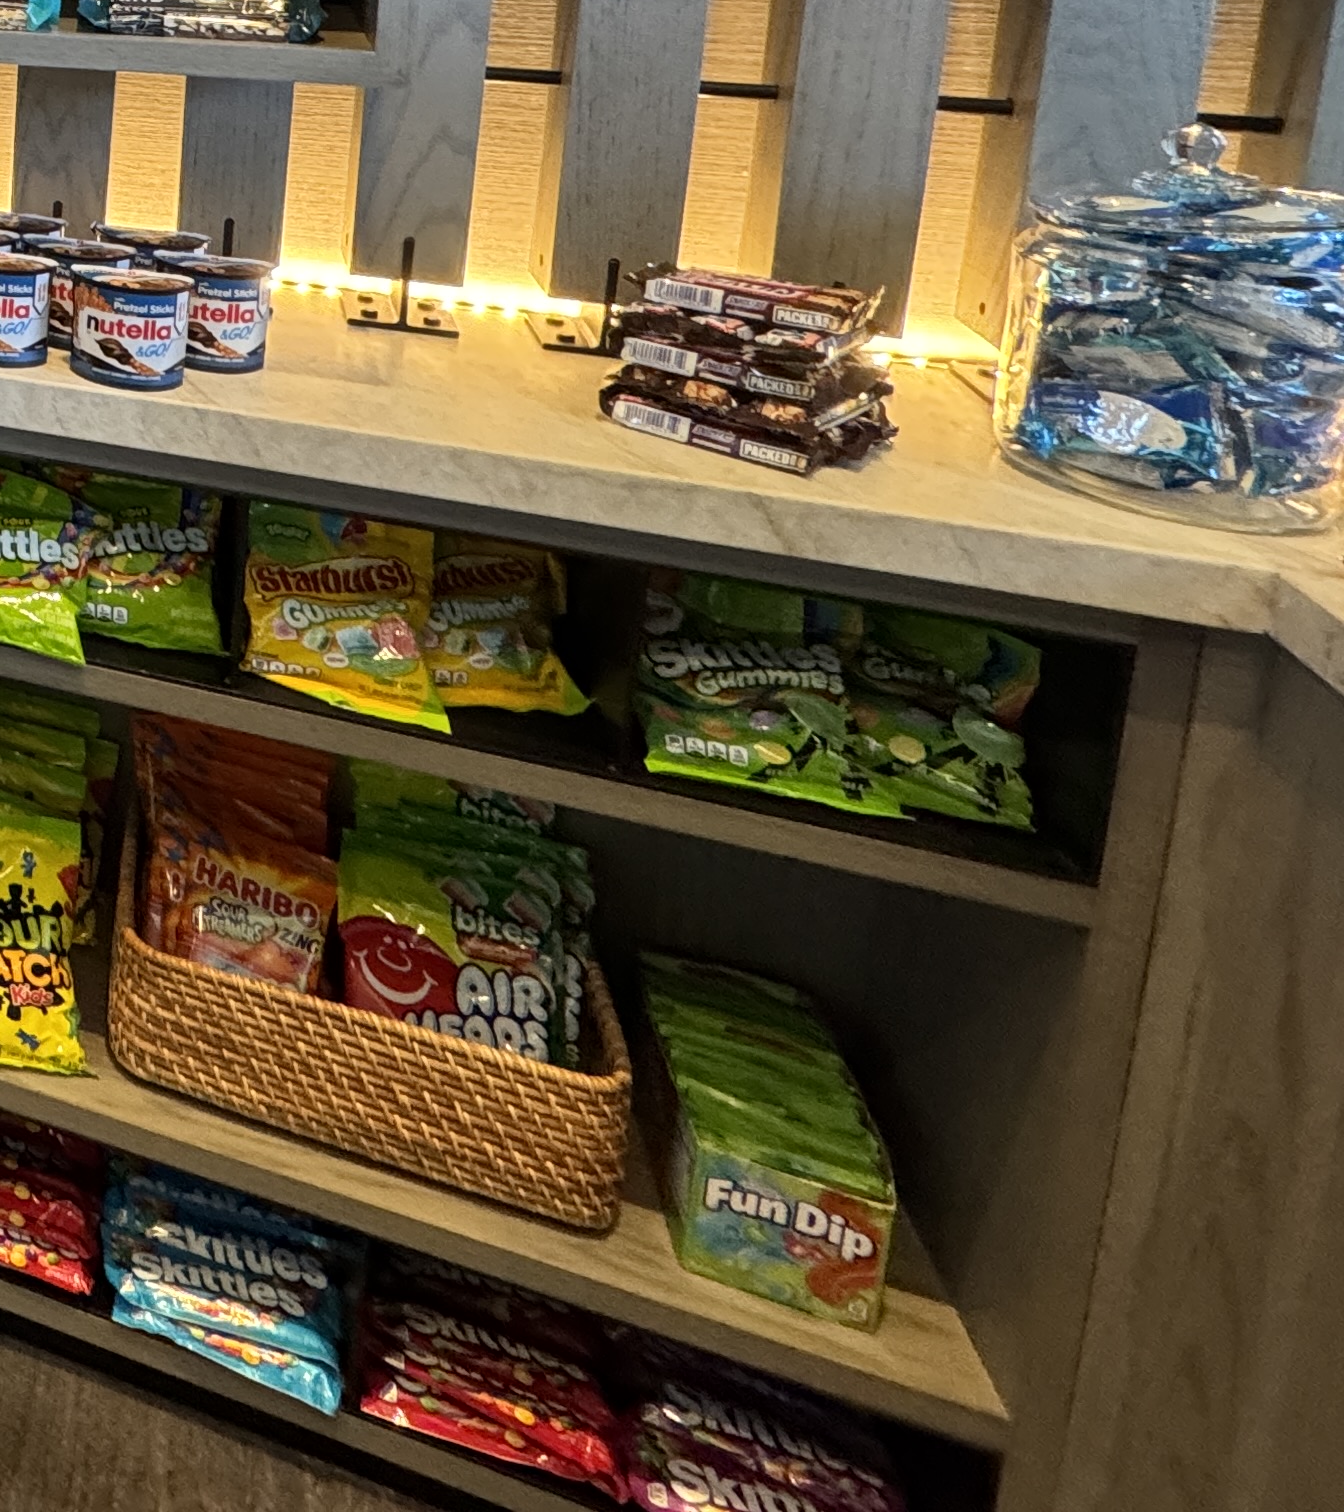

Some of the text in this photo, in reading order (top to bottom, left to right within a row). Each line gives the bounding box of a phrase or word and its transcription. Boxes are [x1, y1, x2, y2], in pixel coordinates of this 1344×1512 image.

[7, 283, 33, 294] Sticks
[197, 284, 232, 298] Pretzel
[113, 301, 175, 315] Pretzel Sticks
[86, 313, 172, 341] nutella
[750, 375, 794, 395] PACKED
[744, 441, 790, 462] PACKED
[94, 520, 208, 558] ittles
[254, 561, 410, 595] Starburst
[193, 854, 320, 929] HARIBO
[210, 897, 248, 921] SOUR
[454, 905, 542, 947] bites
[278, 928, 320, 955] ZING
[9, 983, 55, 1006] Kids
[454, 963, 549, 1023] AIR
[704, 1177, 876, 1262] Fun Dip
[130, 1250, 306, 1318] Skittles
